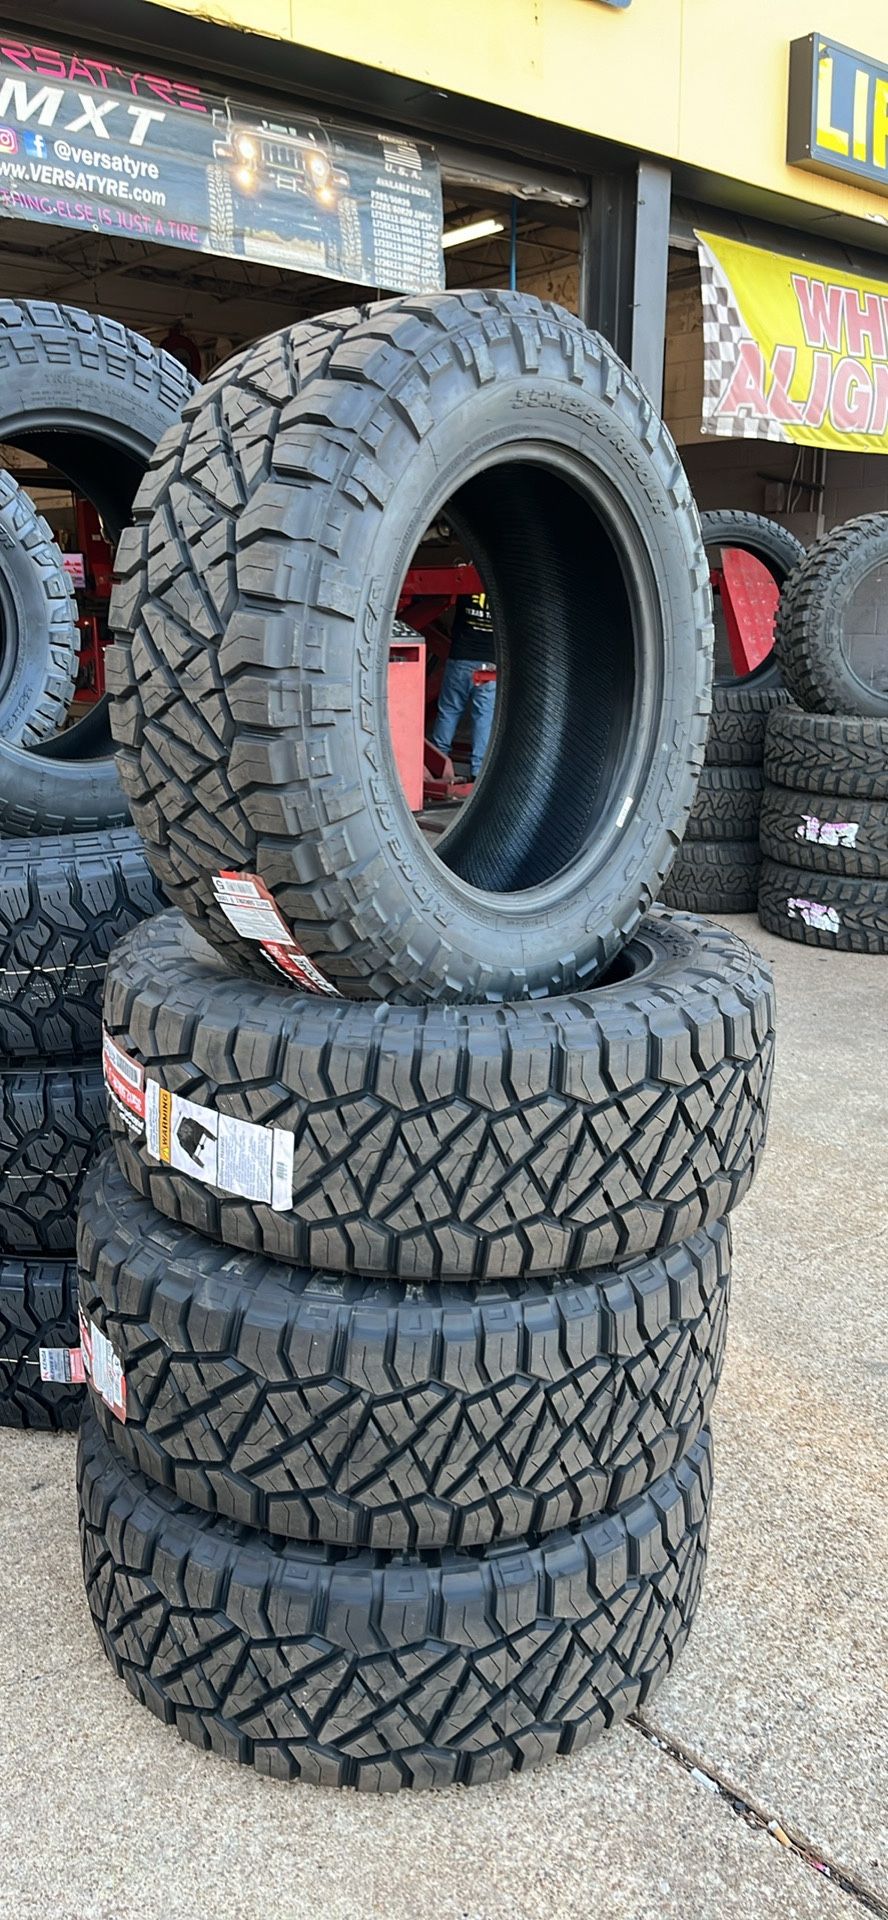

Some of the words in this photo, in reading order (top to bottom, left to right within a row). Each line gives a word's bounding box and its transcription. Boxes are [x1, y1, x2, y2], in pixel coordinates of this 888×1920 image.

[0, 77, 166, 147] MXT
[54, 140, 160, 180] @versatyre
[56, 199, 94, 223] ELSE
[98, 207, 112, 226] IS
[117, 211, 150, 234] JUST
[155, 220, 165, 237] A
[161, 1093, 169, 1146] WARNING
